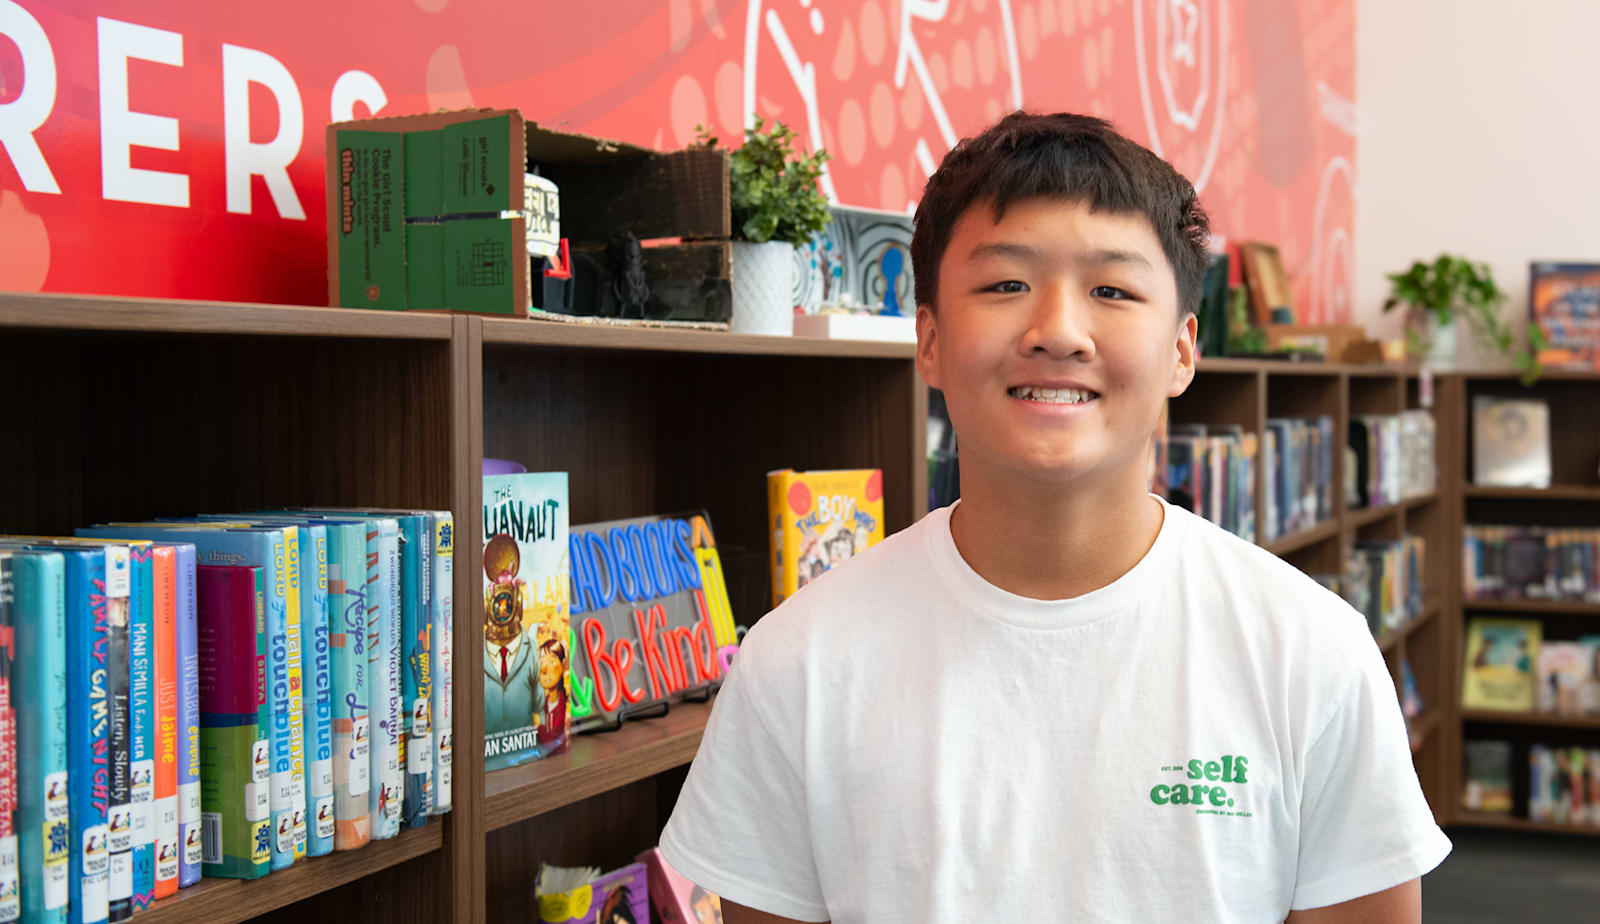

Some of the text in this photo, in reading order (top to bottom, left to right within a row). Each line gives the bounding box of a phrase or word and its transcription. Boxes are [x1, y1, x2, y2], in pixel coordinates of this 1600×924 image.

[341, 149, 355, 234] thin mints
[382, 148, 392, 233] The Girl Scout
[480, 156, 488, 188] scouts
[370, 149, 381, 248] Cookie Program.
[494, 484, 513, 502] THE
[795, 511, 821, 534] THE
[817, 494, 856, 524] BOY
[484, 499, 559, 543] UANAUT
[208, 549, 247, 564] things.
[273, 543, 285, 596] LORD
[288, 538, 299, 588] LORD
[316, 538, 328, 590] LORD
[609, 518, 701, 602] BOOKS
[186, 563, 195, 621] LIBENSON
[389, 555, 397, 606] WONDROUS
[255, 591, 264, 634] LOMBARD
[344, 584, 368, 655] Recipe
[132, 622, 147, 656] MANI
[287, 623, 302, 666] half
[441, 644, 451, 656] of
[584, 618, 645, 712] Be
[633, 589, 720, 700] Kind
[133, 658, 147, 706] SEMILLA
[257, 659, 265, 701] DRITA
[289, 676, 301, 690] a
[355, 664, 365, 691] FOR
[389, 647, 398, 696] VIOLET
[418, 652, 430, 684] WHAT
[443, 658, 451, 674] the
[89, 578, 109, 818] FAMILY GAME NIGHT
[184, 654, 200, 776] INVISIBLE emmie
[442, 676, 451, 719] Universe
[159, 678, 175, 763] JUST Jaime
[501, 730, 538, 753] SANTAT
[112, 694, 128, 801] Listen, Slowly
[134, 736, 144, 759] HER
[1187, 755, 1248, 784] self
[1150, 783, 1235, 807] care.
